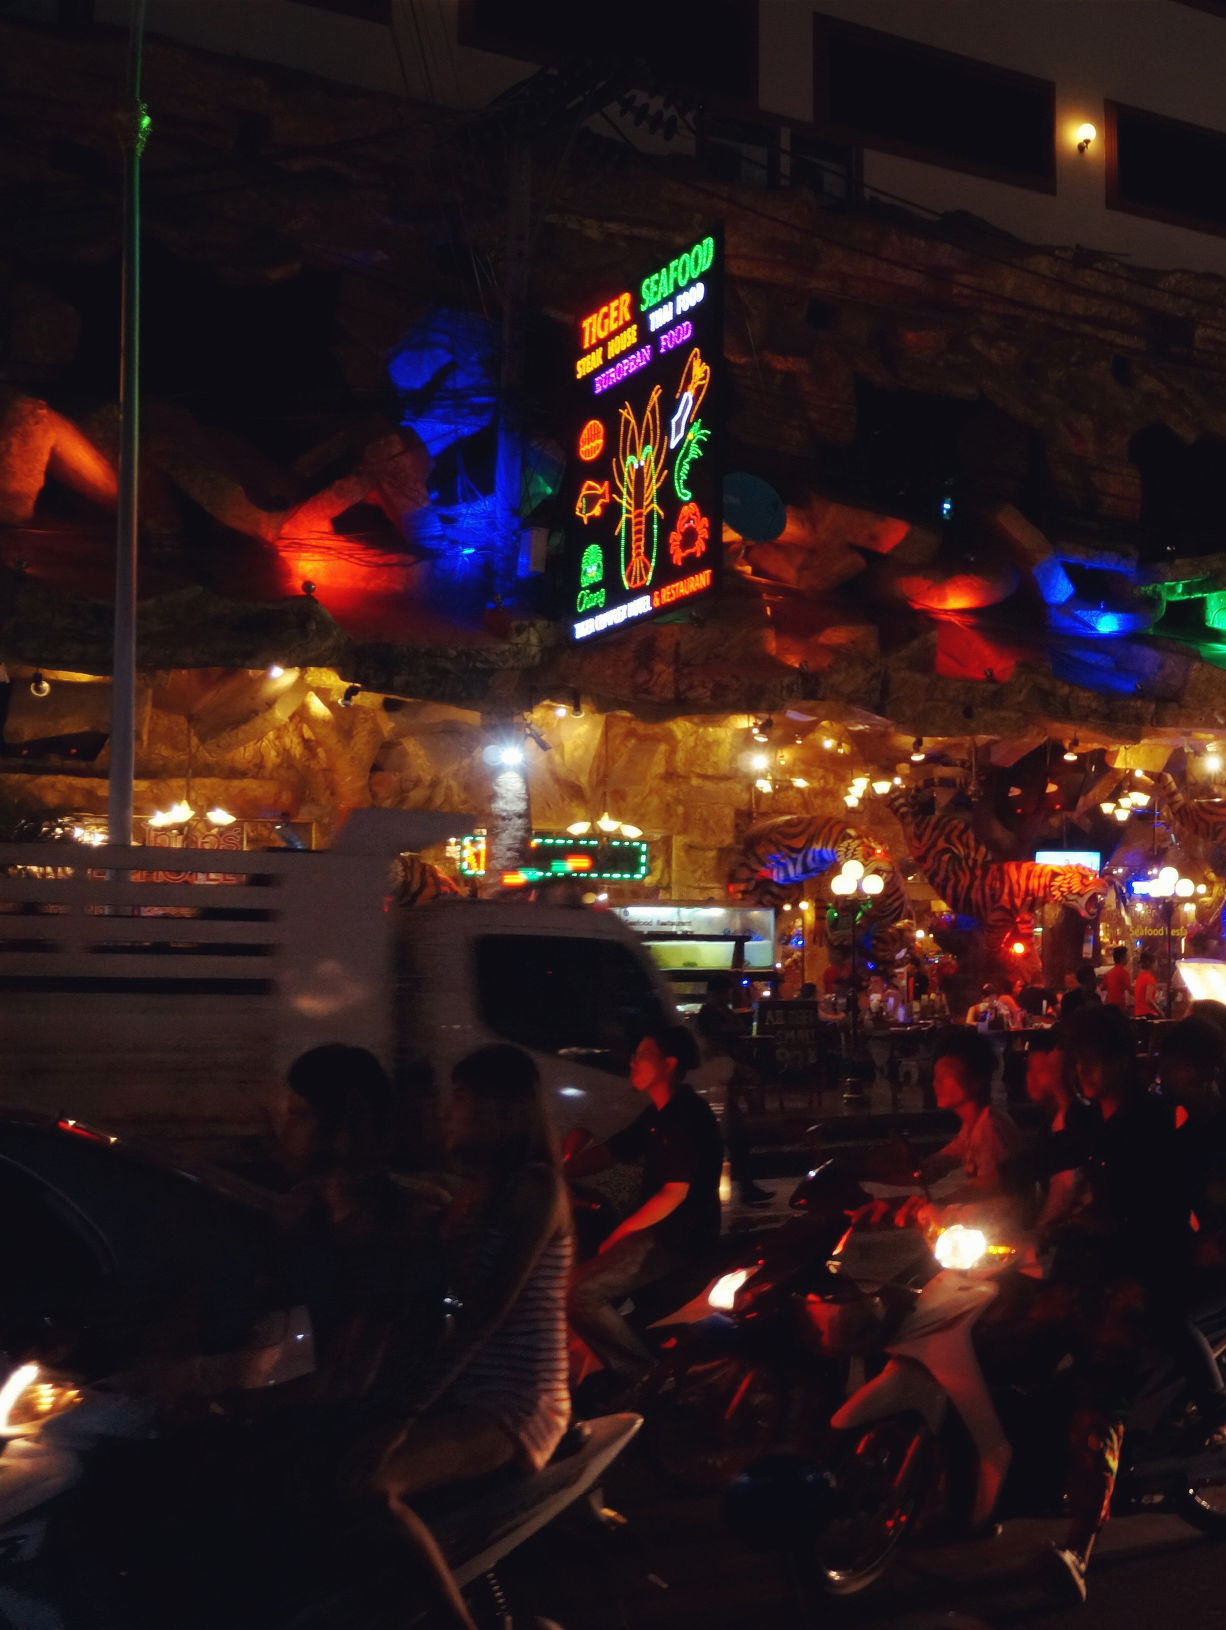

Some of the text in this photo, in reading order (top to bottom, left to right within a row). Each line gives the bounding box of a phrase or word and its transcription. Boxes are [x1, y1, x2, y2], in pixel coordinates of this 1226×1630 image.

[640, 236, 714, 312] SEAFOOD
[582, 291, 632, 349] TIGER
[649, 282, 705, 333] THAI FOOD
[576, 323, 637, 380] STEAK HOUSE
[593, 320, 693, 395] EUROPEAN FOOD
[660, 568, 712, 605] RESTAURANT
